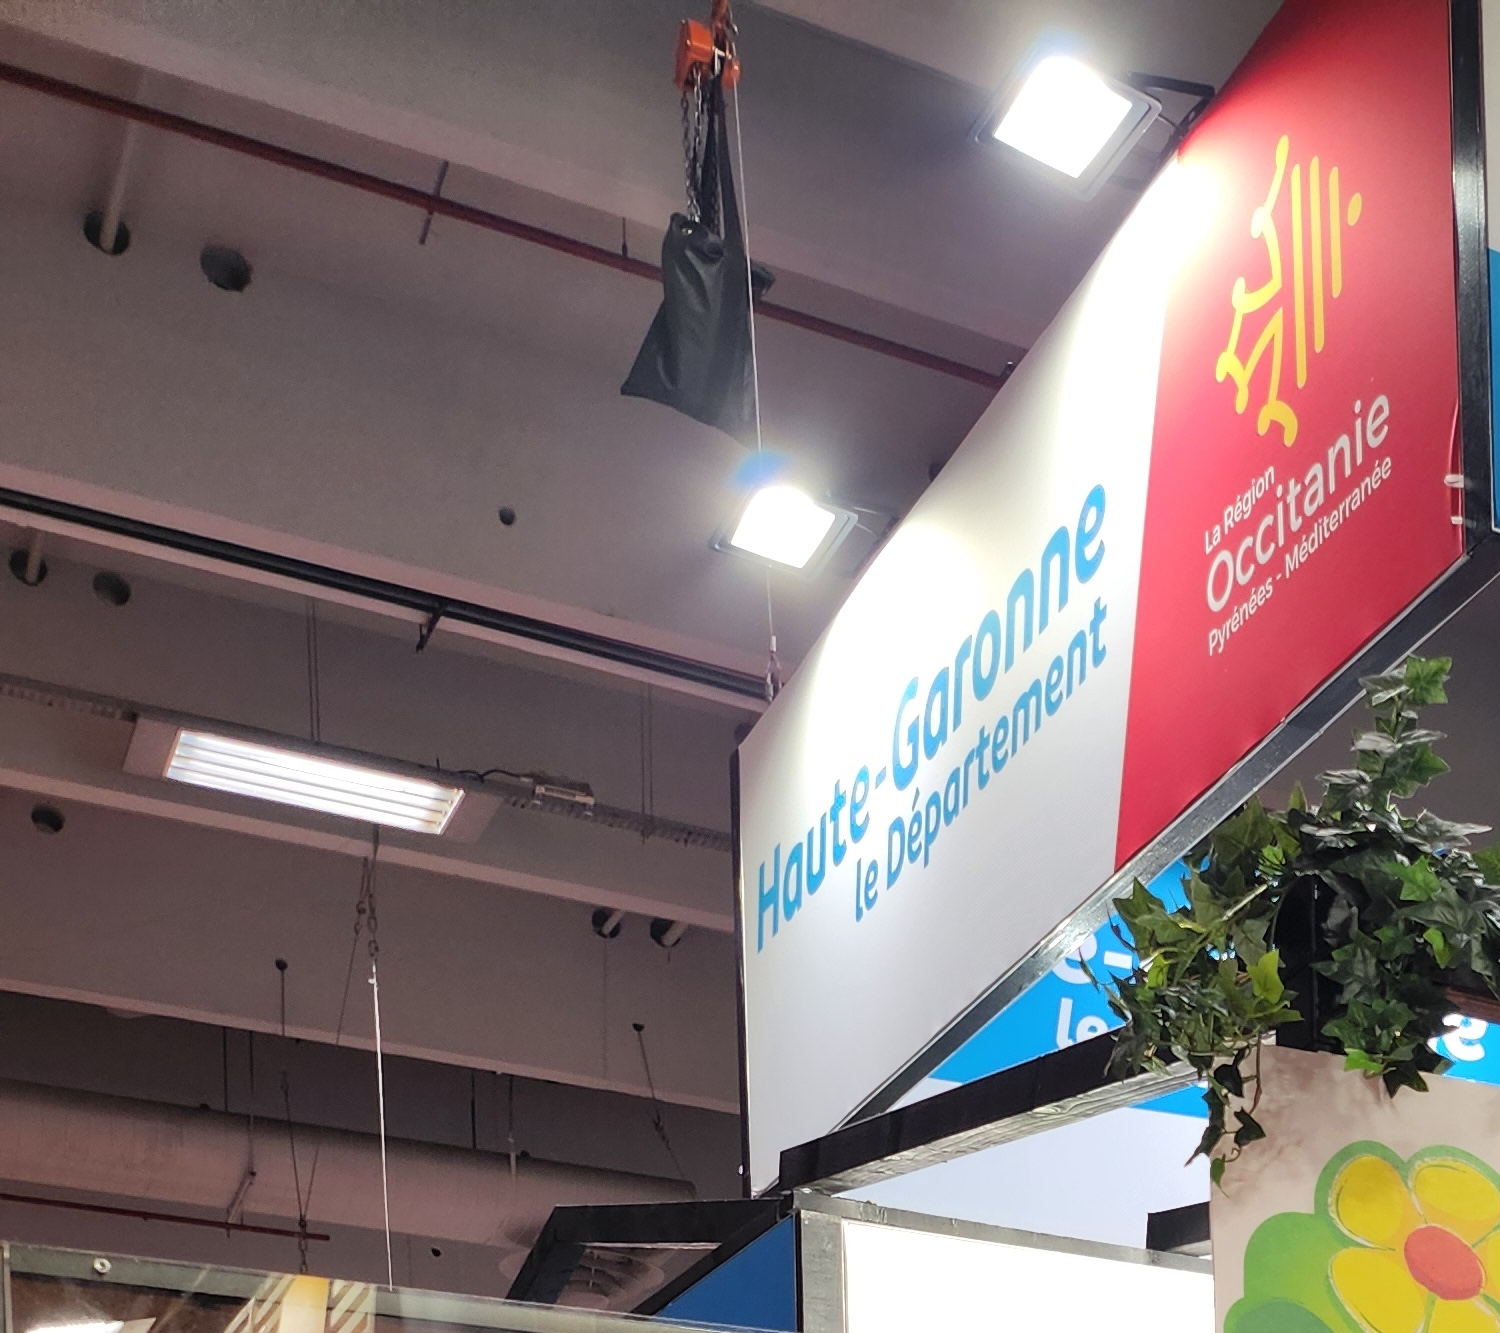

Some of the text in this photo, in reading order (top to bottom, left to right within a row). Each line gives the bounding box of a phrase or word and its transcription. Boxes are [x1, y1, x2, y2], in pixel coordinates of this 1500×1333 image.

[1205, 465, 1276, 555] La Région
[1206, 394, 1390, 613] Occitanie
[1208, 573, 1274, 656] Pyrénées
[1284, 456, 1393, 579] Méditerranée
[758, 484, 1107, 953] Haute-Garonne
[855, 858, 879, 923] le
[887, 597, 1108, 890] Département
